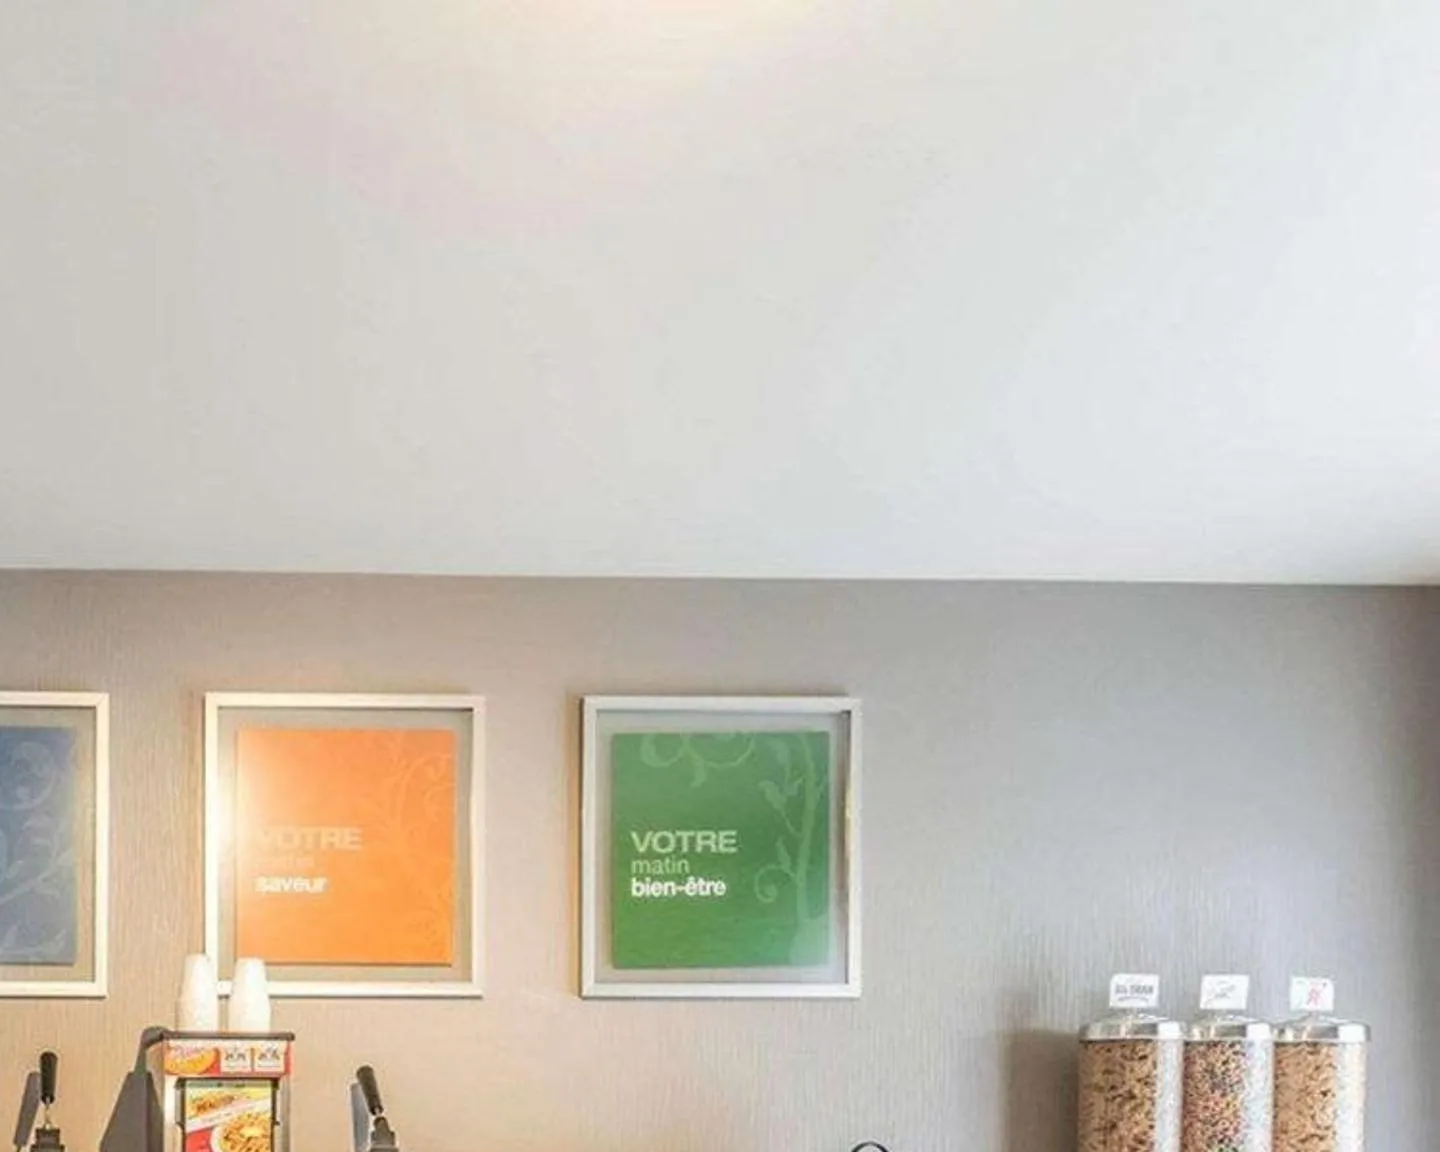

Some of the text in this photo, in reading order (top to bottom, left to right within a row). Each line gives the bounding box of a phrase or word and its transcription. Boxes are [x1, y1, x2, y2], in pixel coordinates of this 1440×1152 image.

[630, 829, 738, 854] VOTRE
[631, 854, 690, 874] matin
[255, 876, 328, 894] saveur
[631, 876, 727, 898] bien-être
